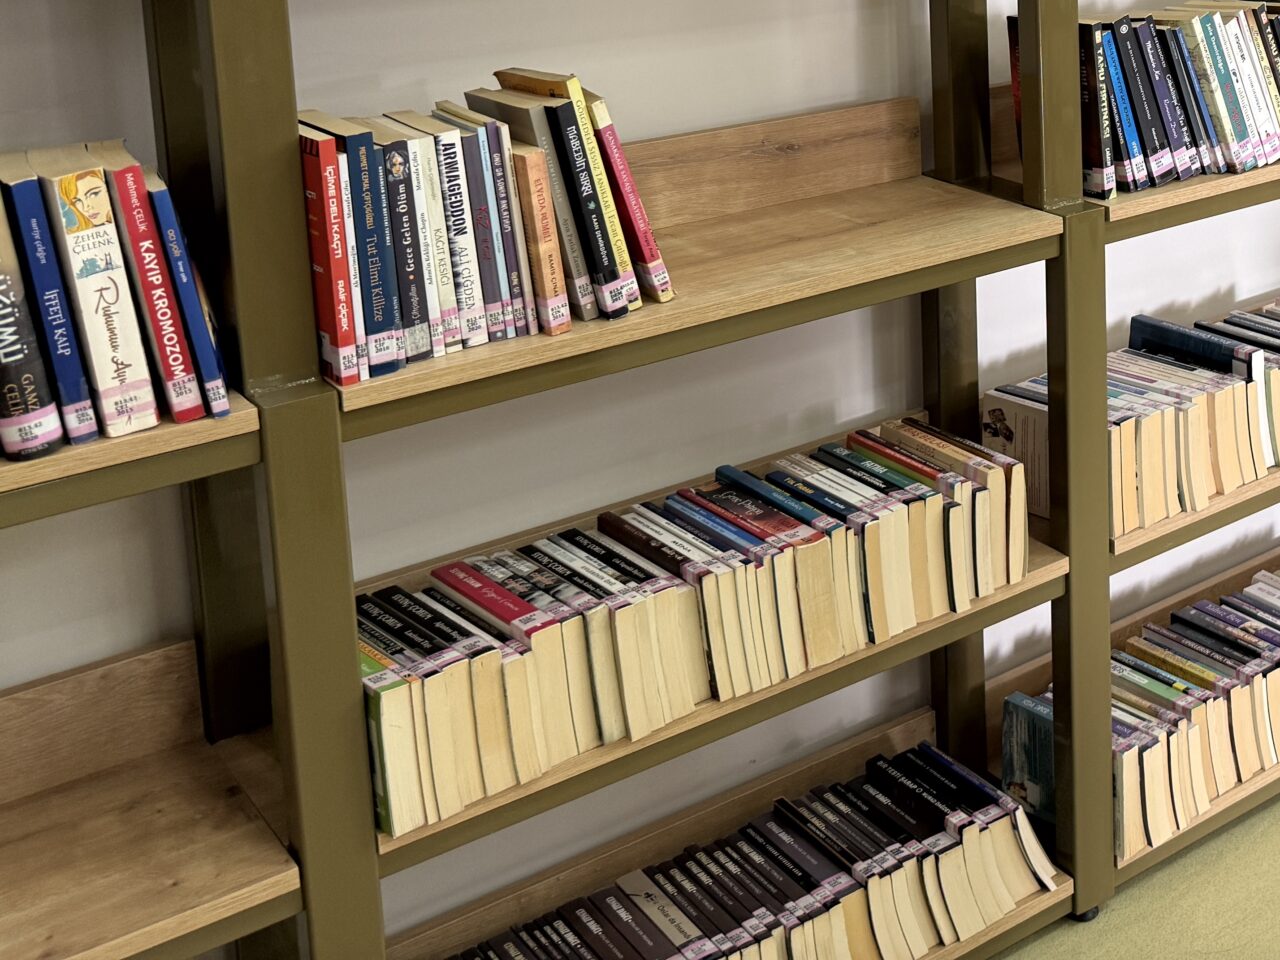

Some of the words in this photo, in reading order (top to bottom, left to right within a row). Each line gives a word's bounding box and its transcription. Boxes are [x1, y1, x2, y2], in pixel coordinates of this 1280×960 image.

[325, 165, 336, 195] İÇİME
[442, 143, 468, 237] ARMAGEDDON
[577, 173, 592, 197] SIRRI
[125, 173, 141, 209] Mehmet
[133, 204, 147, 232] ÇELİK
[328, 198, 339, 222] DELİ
[73, 229, 109, 245] ZEHRA
[401, 215, 411, 245] Gelen
[607, 214, 621, 237] Ercan
[73, 238, 114, 255] ÇELENK
[367, 235, 378, 254] Tut
[369, 257, 380, 285] Elimi
[405, 247, 415, 272] Gece
[95, 276, 121, 354] Ruhumun
[139, 240, 161, 285] KAYIP
[151, 289, 186, 379] KROMOZOM
[371, 288, 383, 322] Killize
[54, 328, 71, 356] KALP
